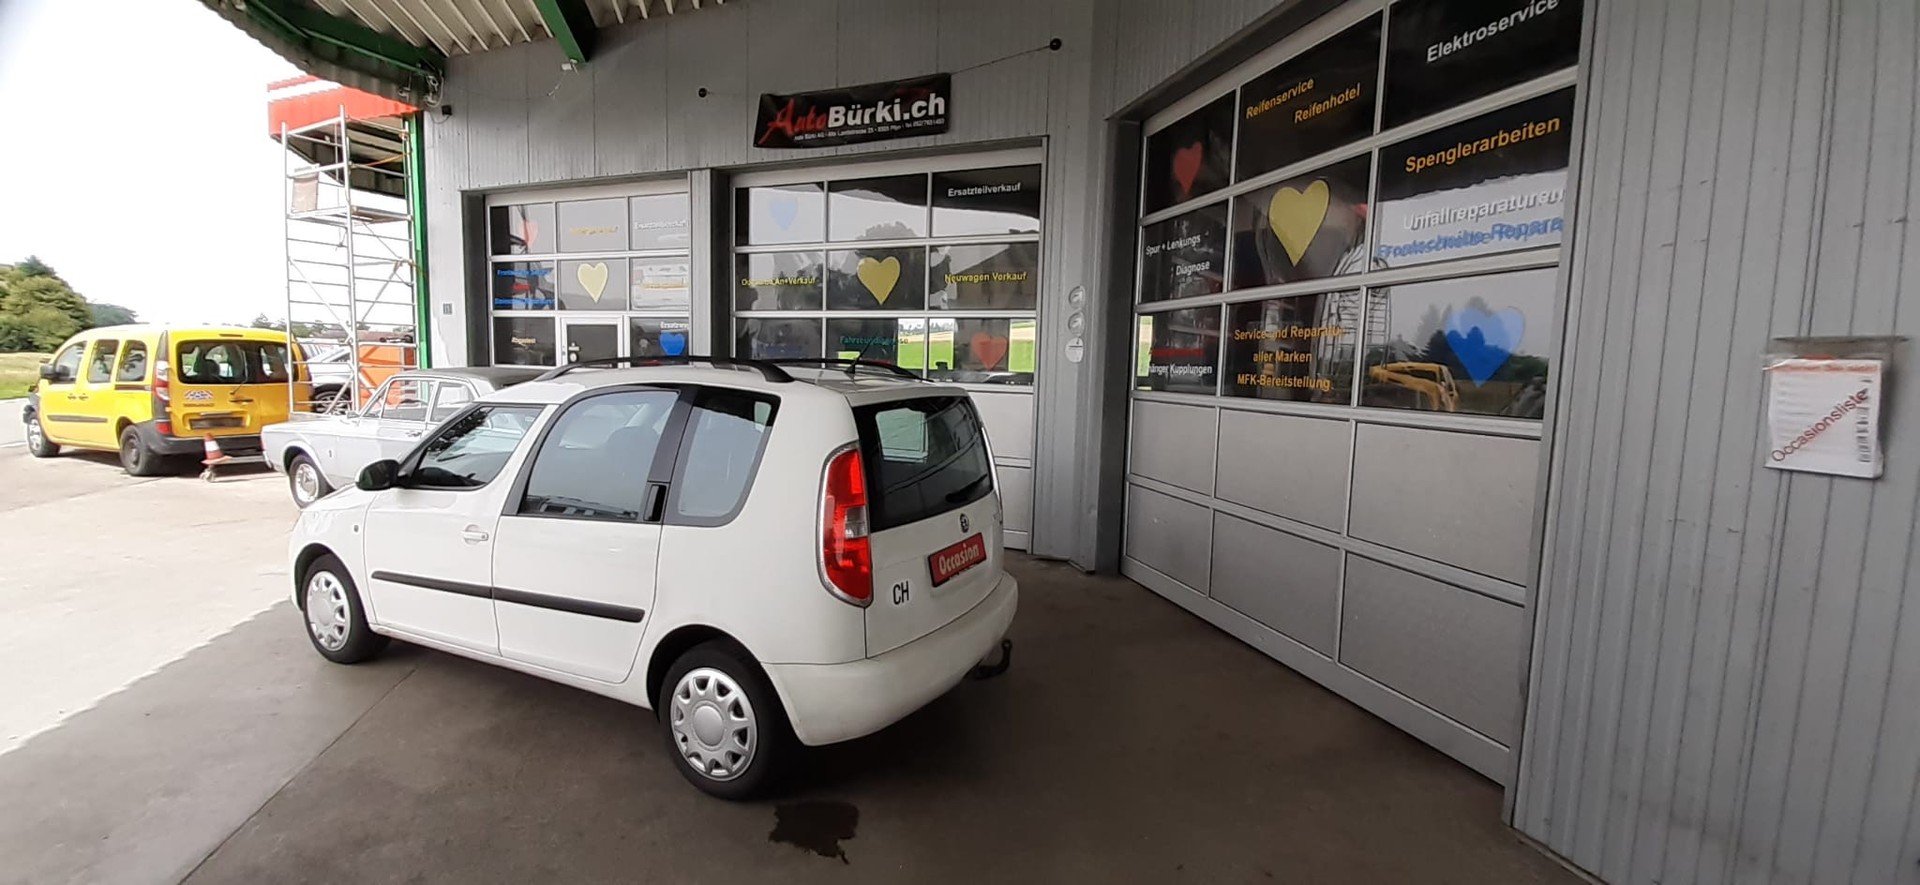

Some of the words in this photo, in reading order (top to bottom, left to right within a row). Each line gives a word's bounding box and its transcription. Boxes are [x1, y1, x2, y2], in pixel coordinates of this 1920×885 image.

[1426, 0, 1560, 64] Elektroservice
[1246, 77, 1315, 120] Reifenservice
[1294, 83, 1361, 124] Reifenhotel
[1405, 117, 1561, 174] Spenglerarbeiten
[947, 181, 1021, 197] Ersatzteilverkauf
[1404, 188, 1566, 231] Unfallreparaturen
[1145, 245, 1161, 257] Spur
[1167, 234, 1201, 250] Lenkungs
[944, 273, 990, 283] Neuwagen
[992, 271, 1028, 281] Verkauf
[1175, 260, 1211, 276] Diagnose
[1234, 329, 1266, 340] Service
[1253, 350, 1274, 363] aller
[1275, 351, 1313, 363] Marken
[1170, 363, 1213, 377] Kupplungen
[1771, 387, 1869, 462] Occasionsliste
[938, 542, 980, 575] Occasion
[892, 580, 910, 605] CH
